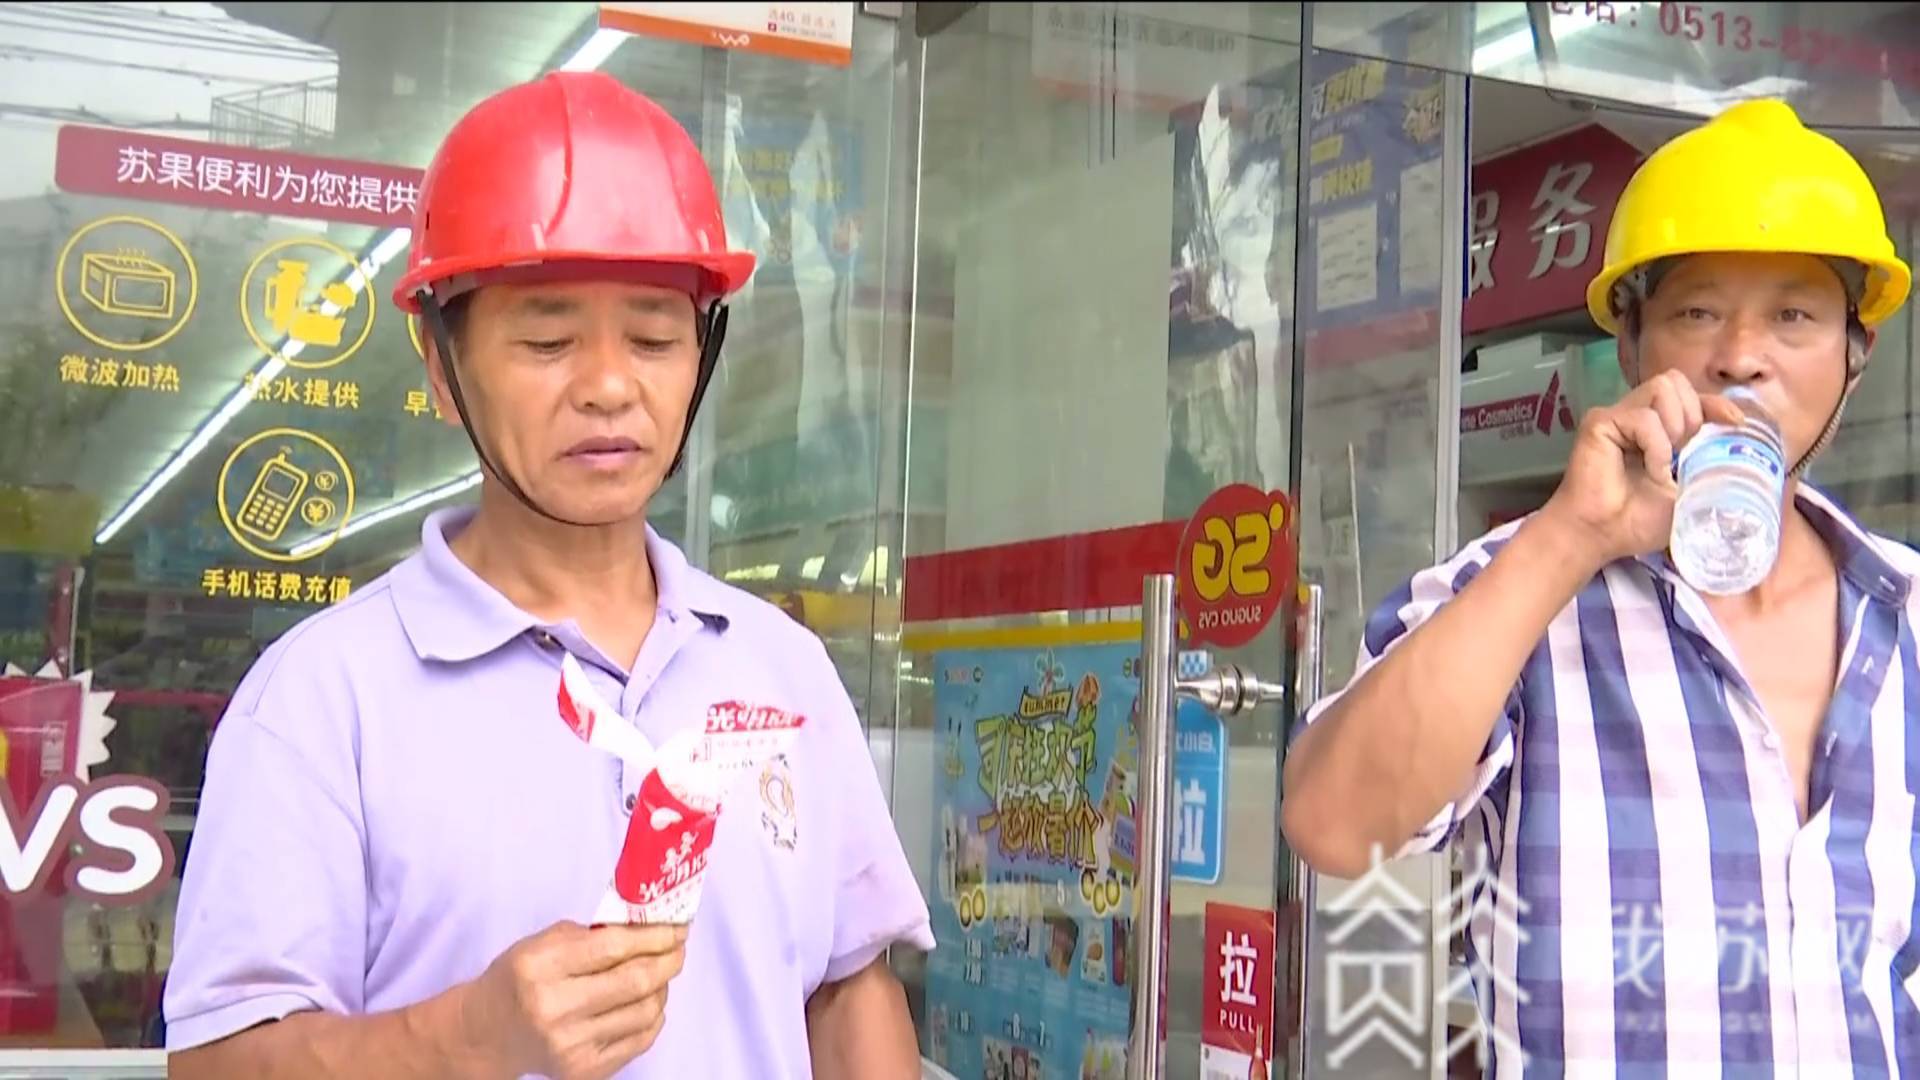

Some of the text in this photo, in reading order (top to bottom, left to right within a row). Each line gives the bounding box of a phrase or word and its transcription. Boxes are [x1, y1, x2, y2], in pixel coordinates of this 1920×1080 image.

[116, 146, 418, 212] 苏果便利为您提供
[60, 355, 180, 392] 微波加热
[245, 372, 361, 408] 热水提供
[202, 569, 352, 603] 手机话费充值
[1219, 930, 1258, 1006] 拉
[1219, 1008, 1255, 1033] PULL
